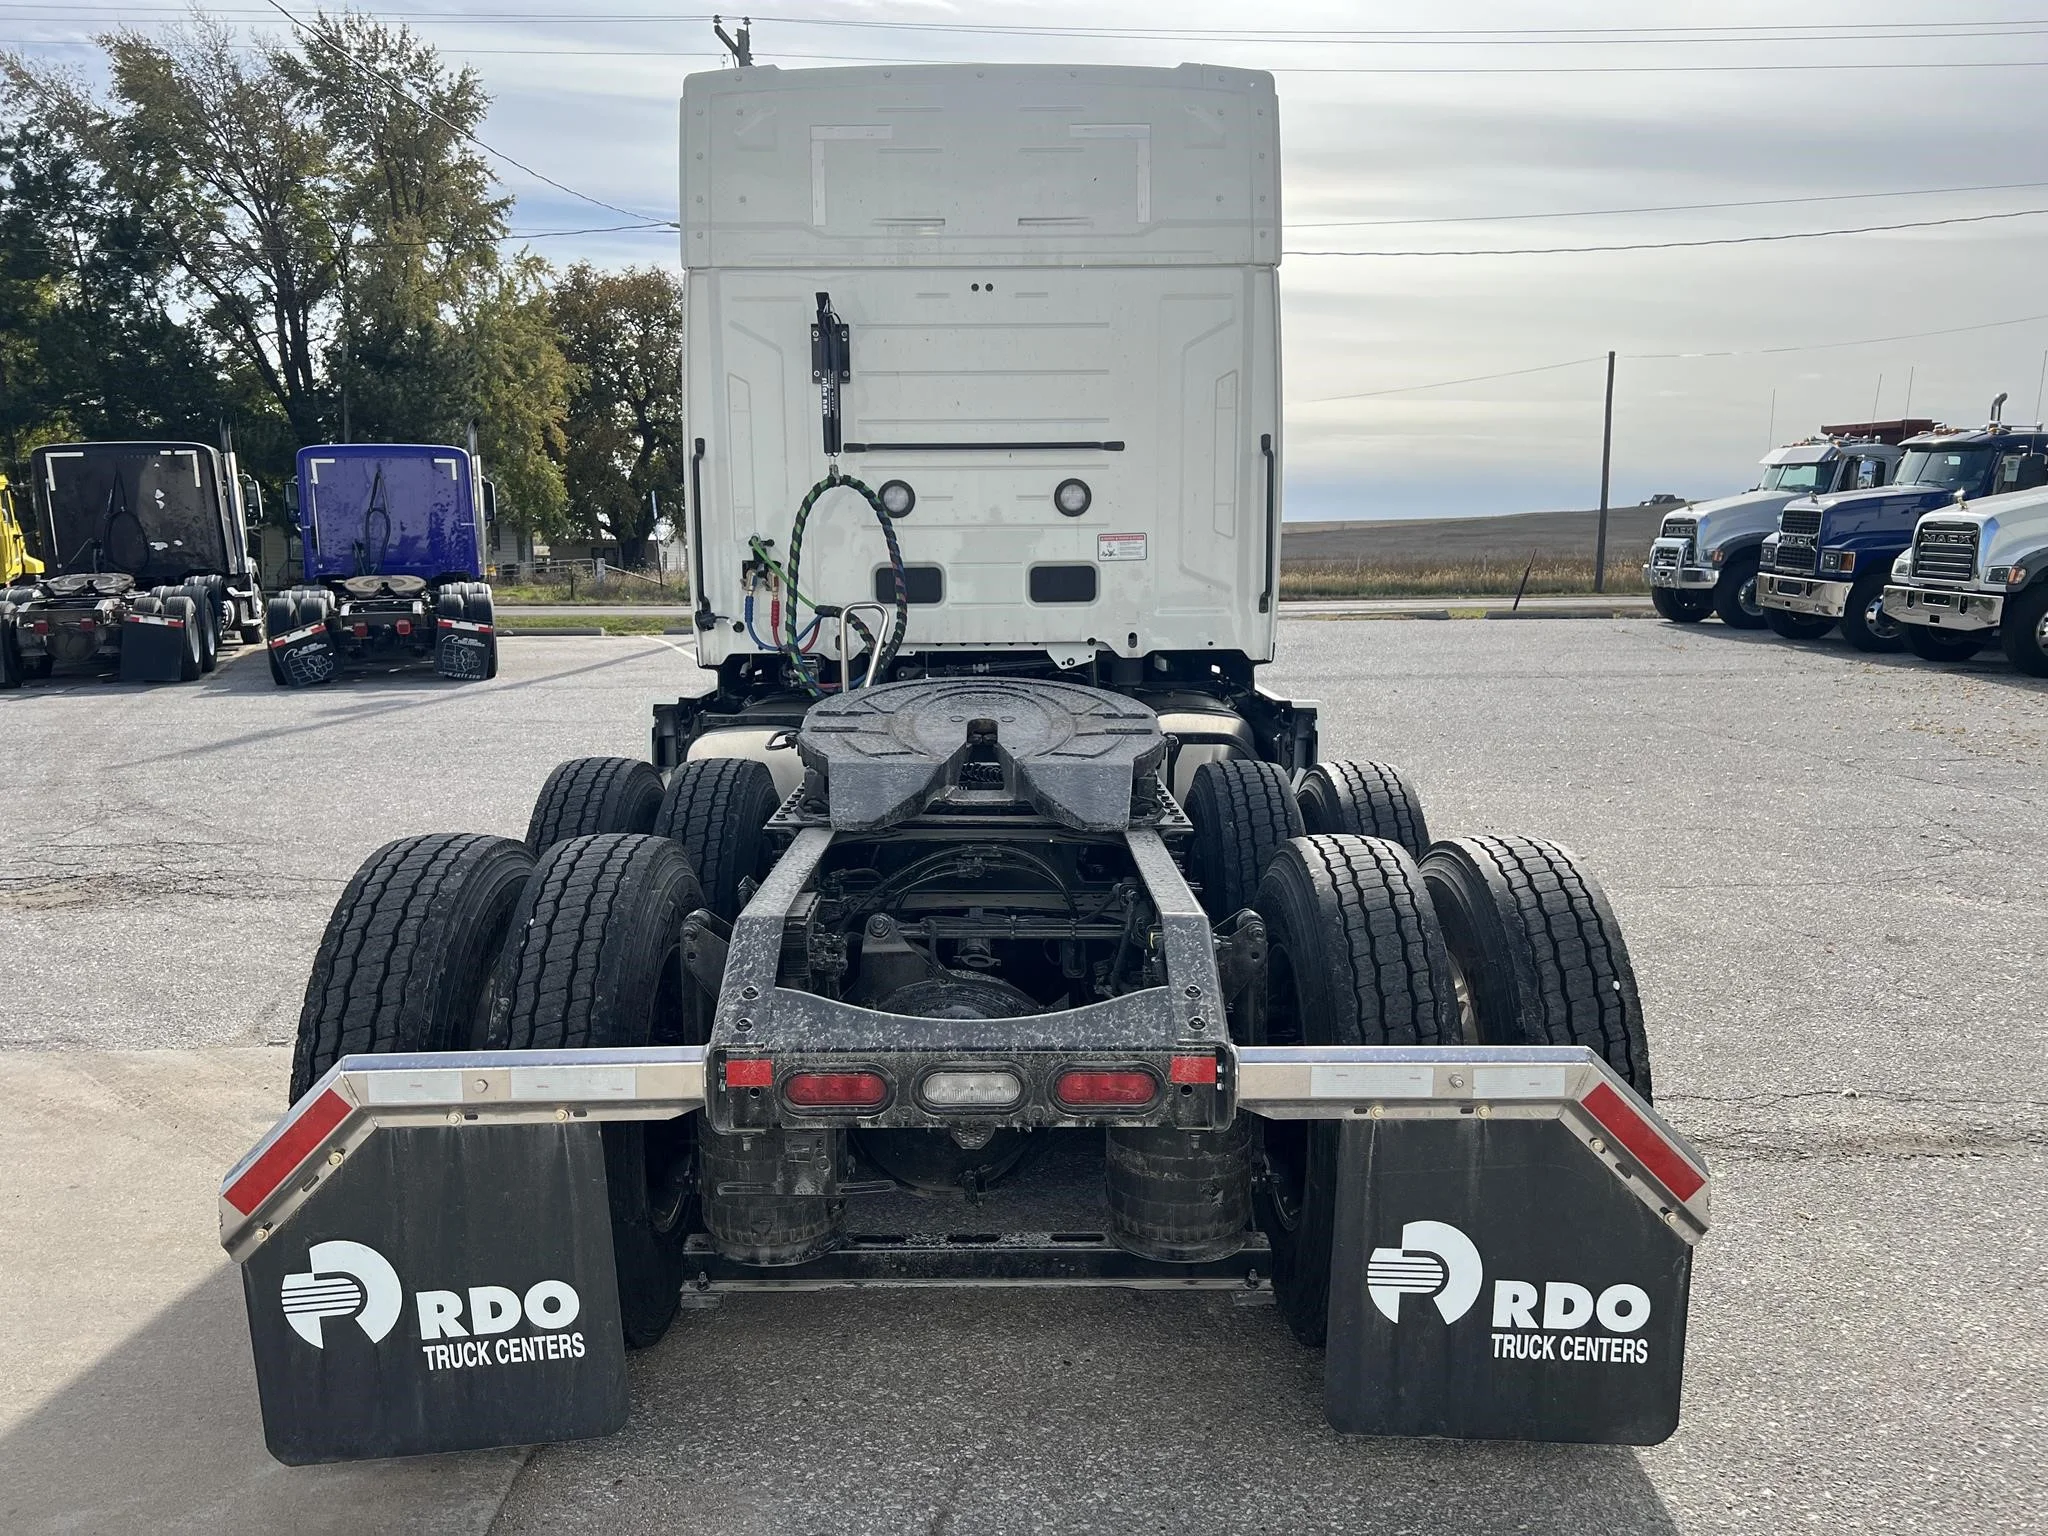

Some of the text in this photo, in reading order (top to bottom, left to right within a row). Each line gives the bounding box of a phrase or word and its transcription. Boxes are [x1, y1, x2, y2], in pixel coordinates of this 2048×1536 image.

[1781, 535, 1812, 546] MACK
[1924, 534, 1972, 544] MACK
[416, 1280, 579, 1340] RDO
[1492, 1280, 1650, 1332] RDO
[423, 1332, 586, 1370] TRUCK CENTERS
[1492, 1334, 1648, 1364] TRUCK CENTERS
